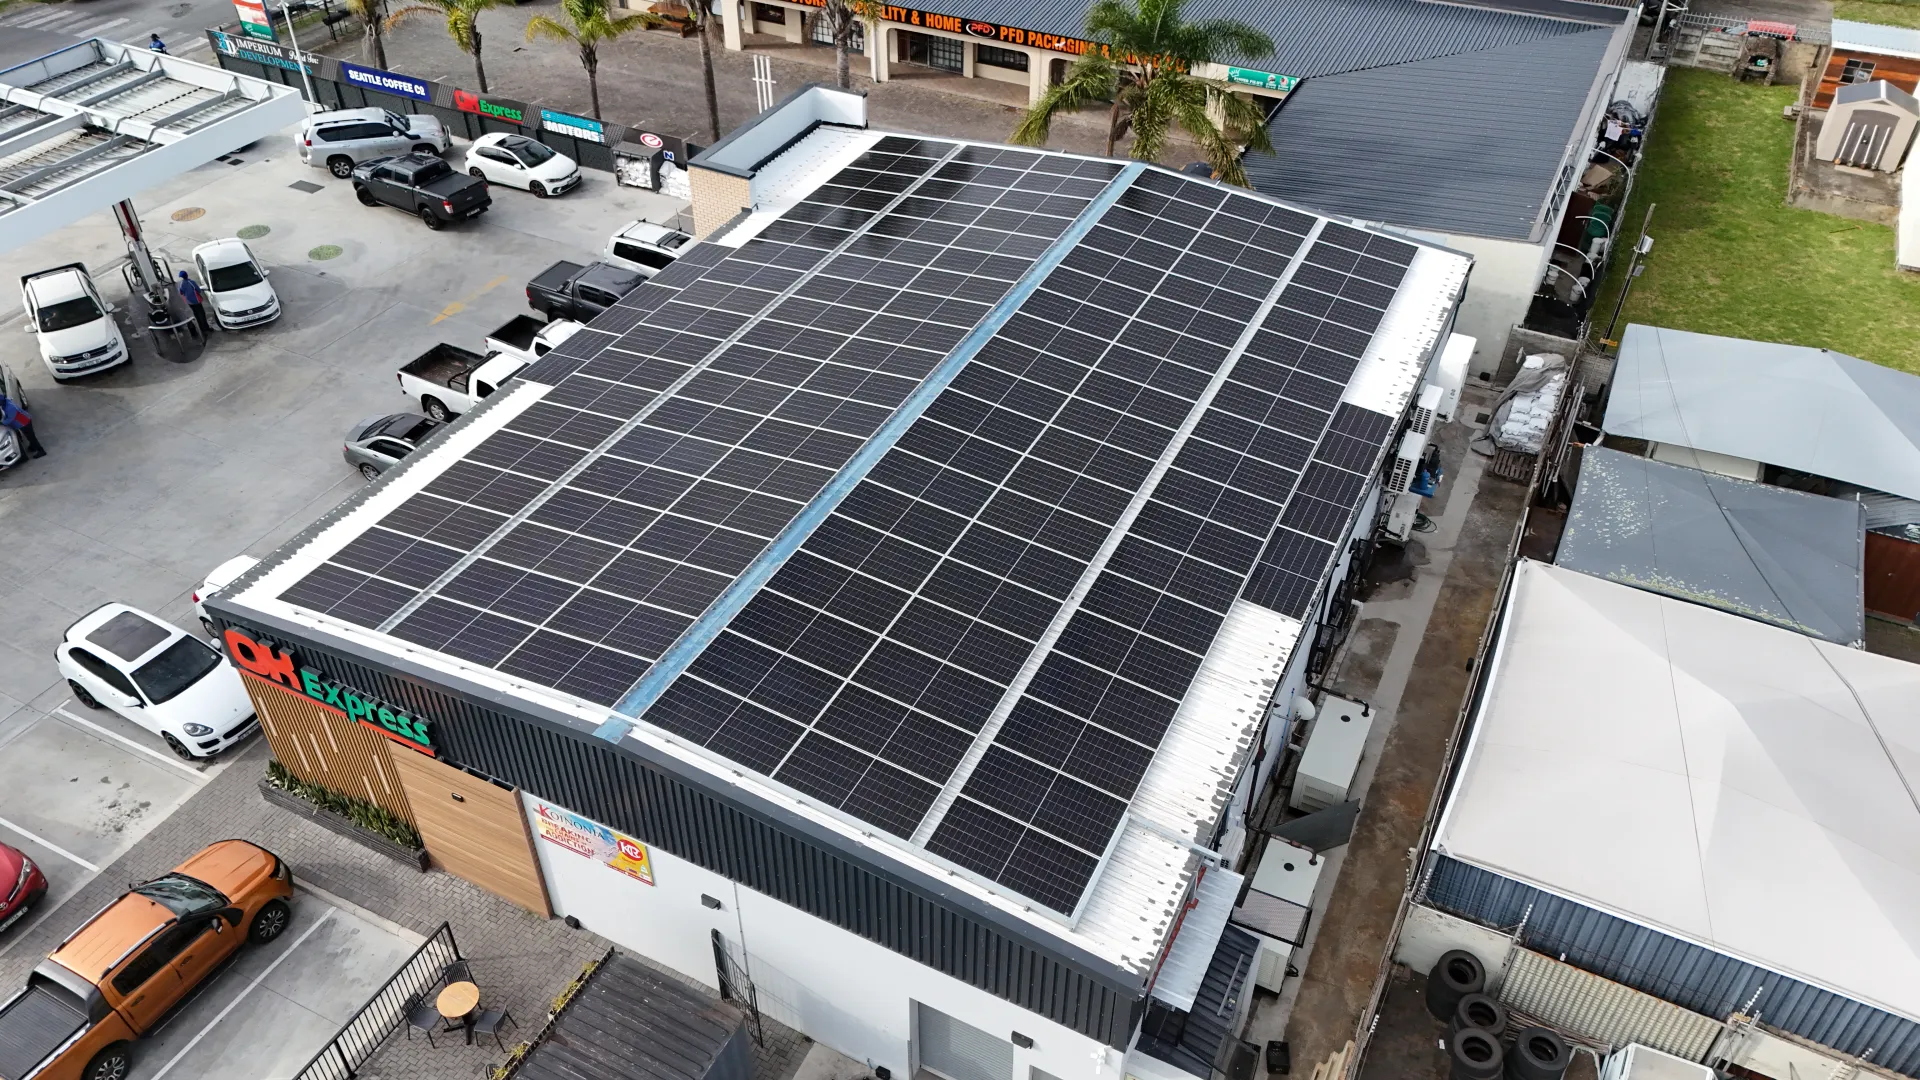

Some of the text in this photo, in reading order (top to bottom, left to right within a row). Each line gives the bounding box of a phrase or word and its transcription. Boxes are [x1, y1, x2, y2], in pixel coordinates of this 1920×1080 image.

[911, 10, 920, 25] &
[925, 13, 962, 33] HOME
[971, 22, 990, 34] PFD
[236, 38, 282, 57] IMPERIUM
[999, 26, 1024, 43] PFD
[1028, 31, 1097, 55] PACKAGING
[348, 69, 383, 86] SEATTLE
[382, 77, 414, 93] COFFEE
[453, 89, 480, 113] OK
[479, 99, 523, 121] Express
[544, 120, 602, 142] MOTORS
[224, 629, 430, 746] OK Express
[538, 804, 606, 840] KOINONIA
[545, 829, 595, 856] ADDICTION
